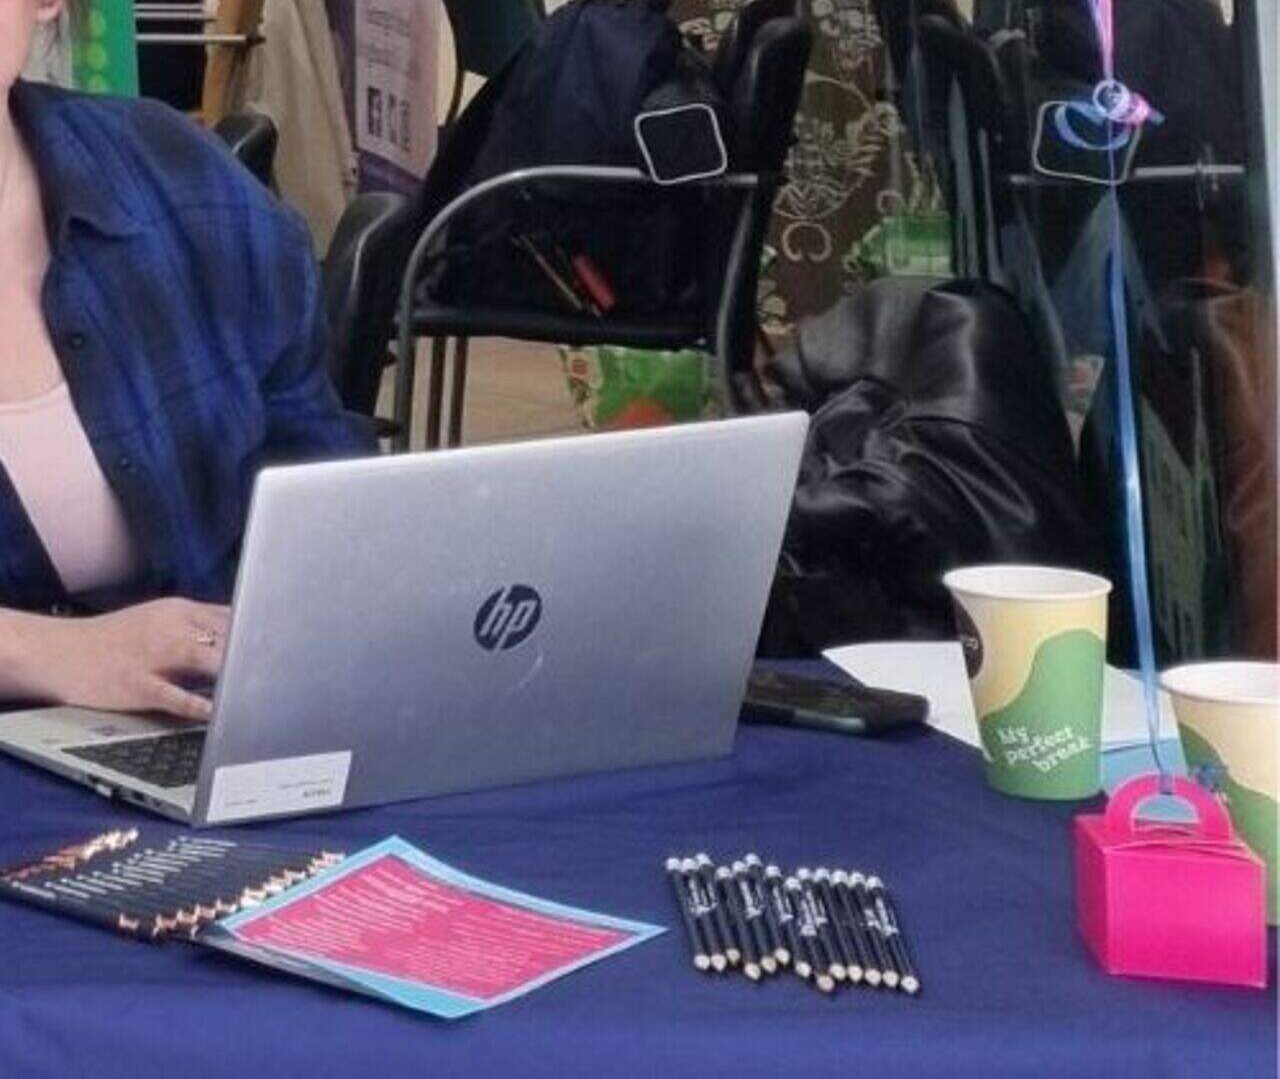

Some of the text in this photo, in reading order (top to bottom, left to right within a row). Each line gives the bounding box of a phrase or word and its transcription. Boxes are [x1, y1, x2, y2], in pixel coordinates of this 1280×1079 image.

[475, 584, 542, 652] hp
[1005, 727, 1074, 765] perfect
[1031, 737, 1094, 773] break
